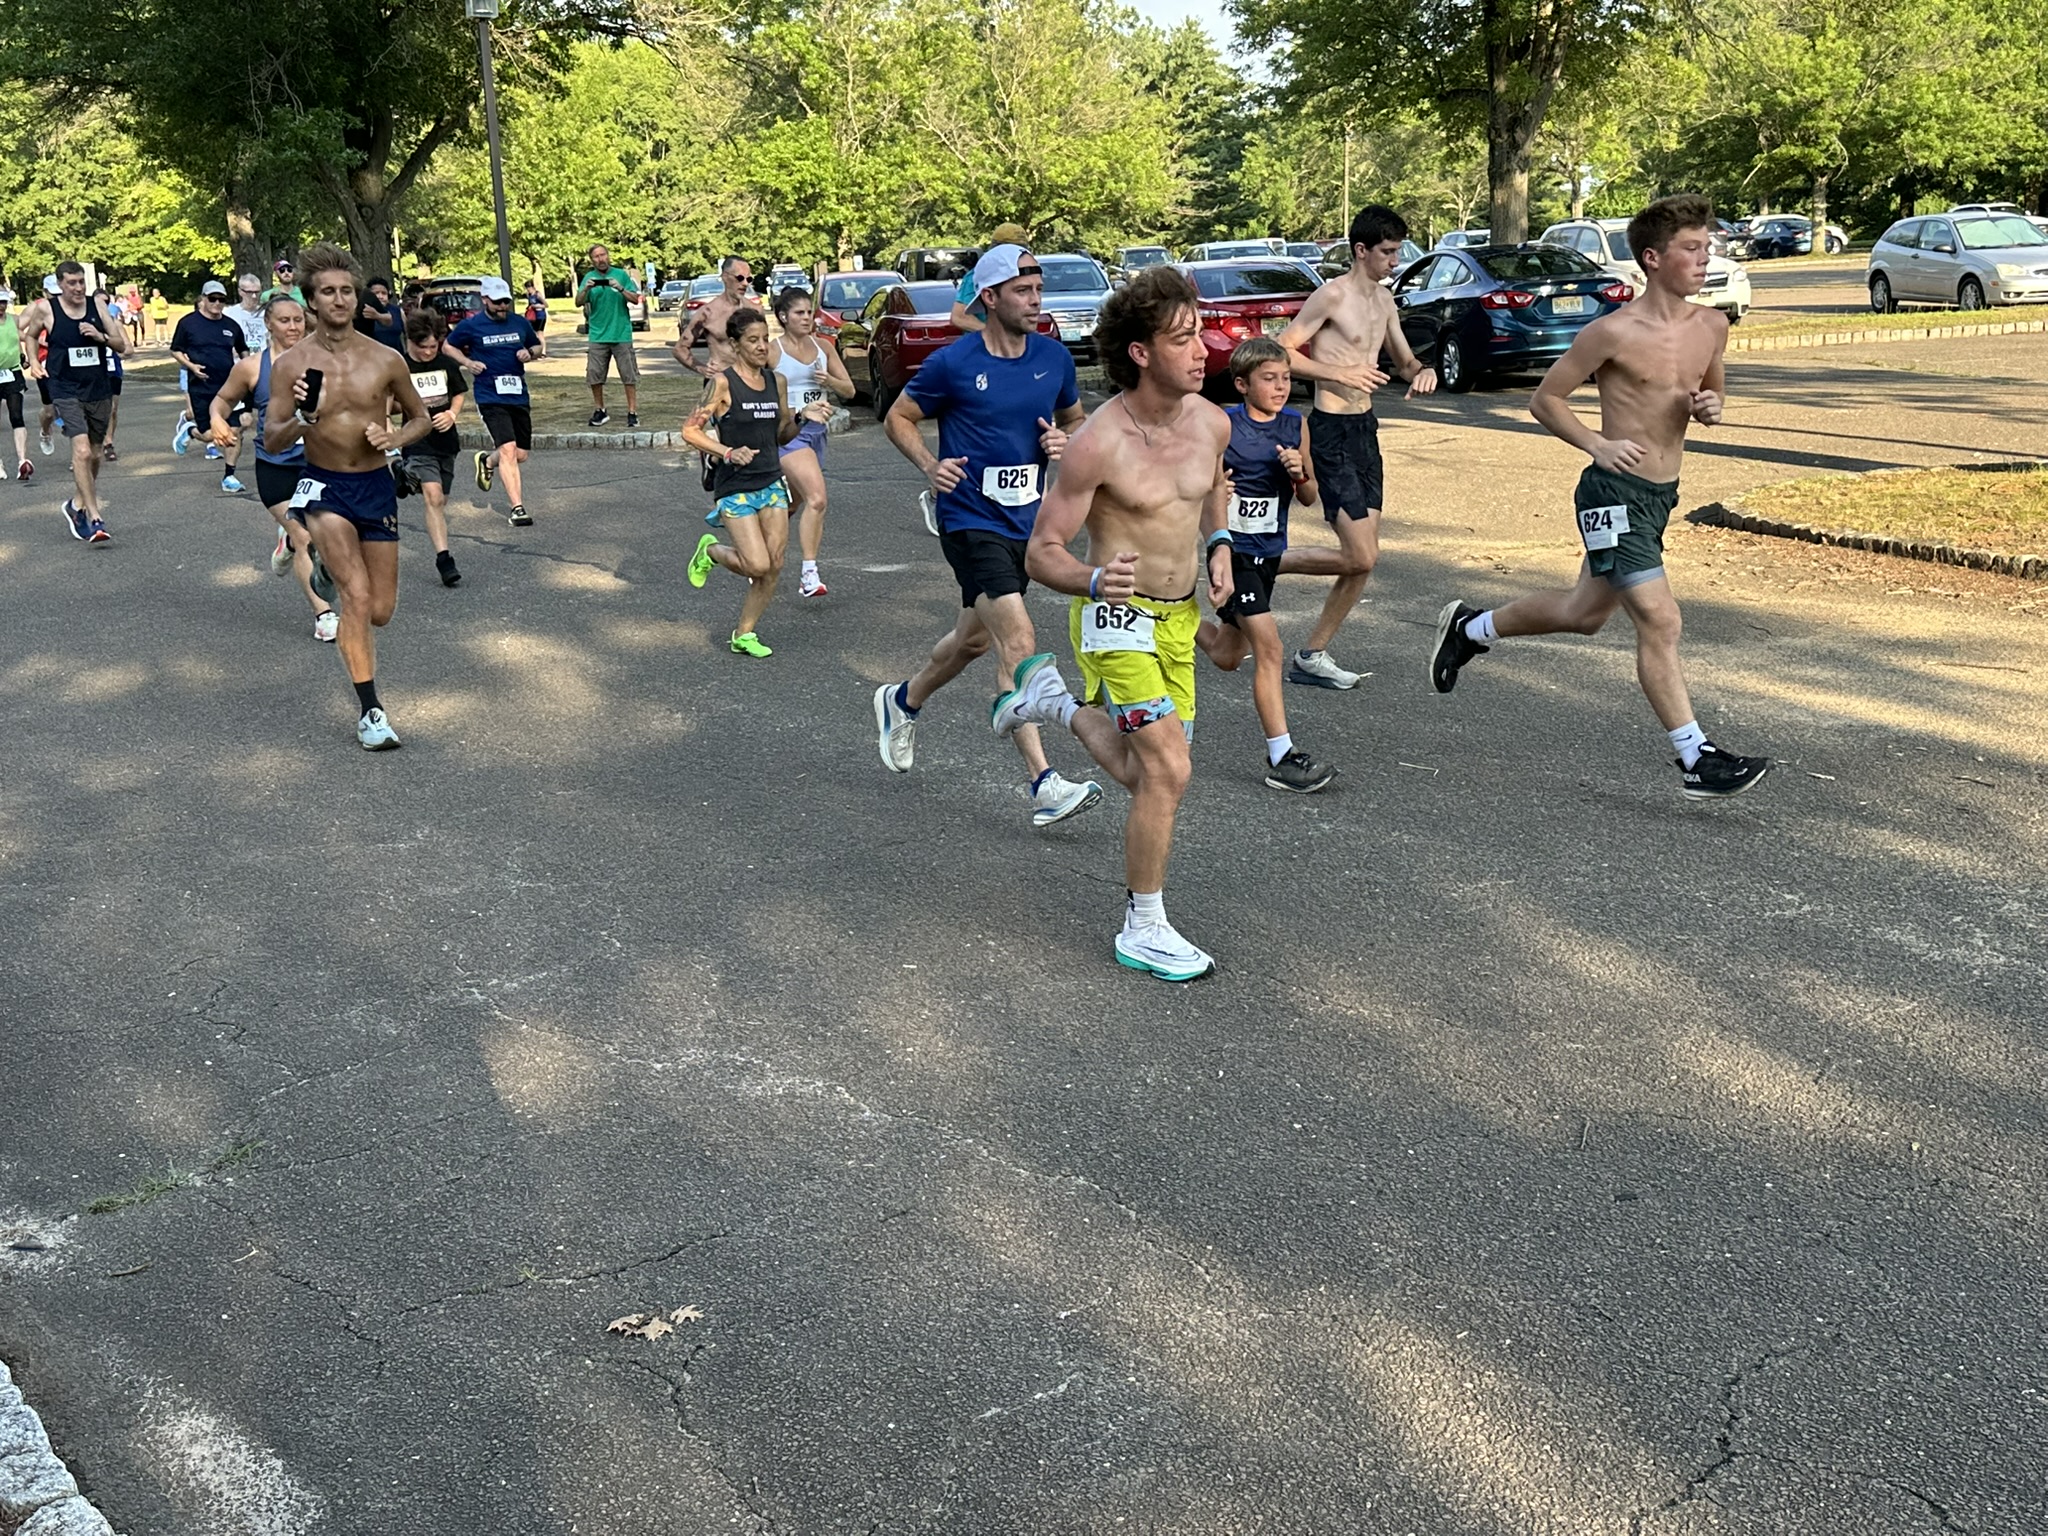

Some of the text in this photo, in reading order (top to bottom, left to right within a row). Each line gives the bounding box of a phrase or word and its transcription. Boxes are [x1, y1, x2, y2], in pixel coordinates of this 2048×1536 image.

[416, 375, 438, 389] 649
[997, 468, 1029, 489] 625
[1238, 499, 1270, 518] 623
[1583, 509, 1613, 534] 624
[1095, 604, 1137, 633] 652
